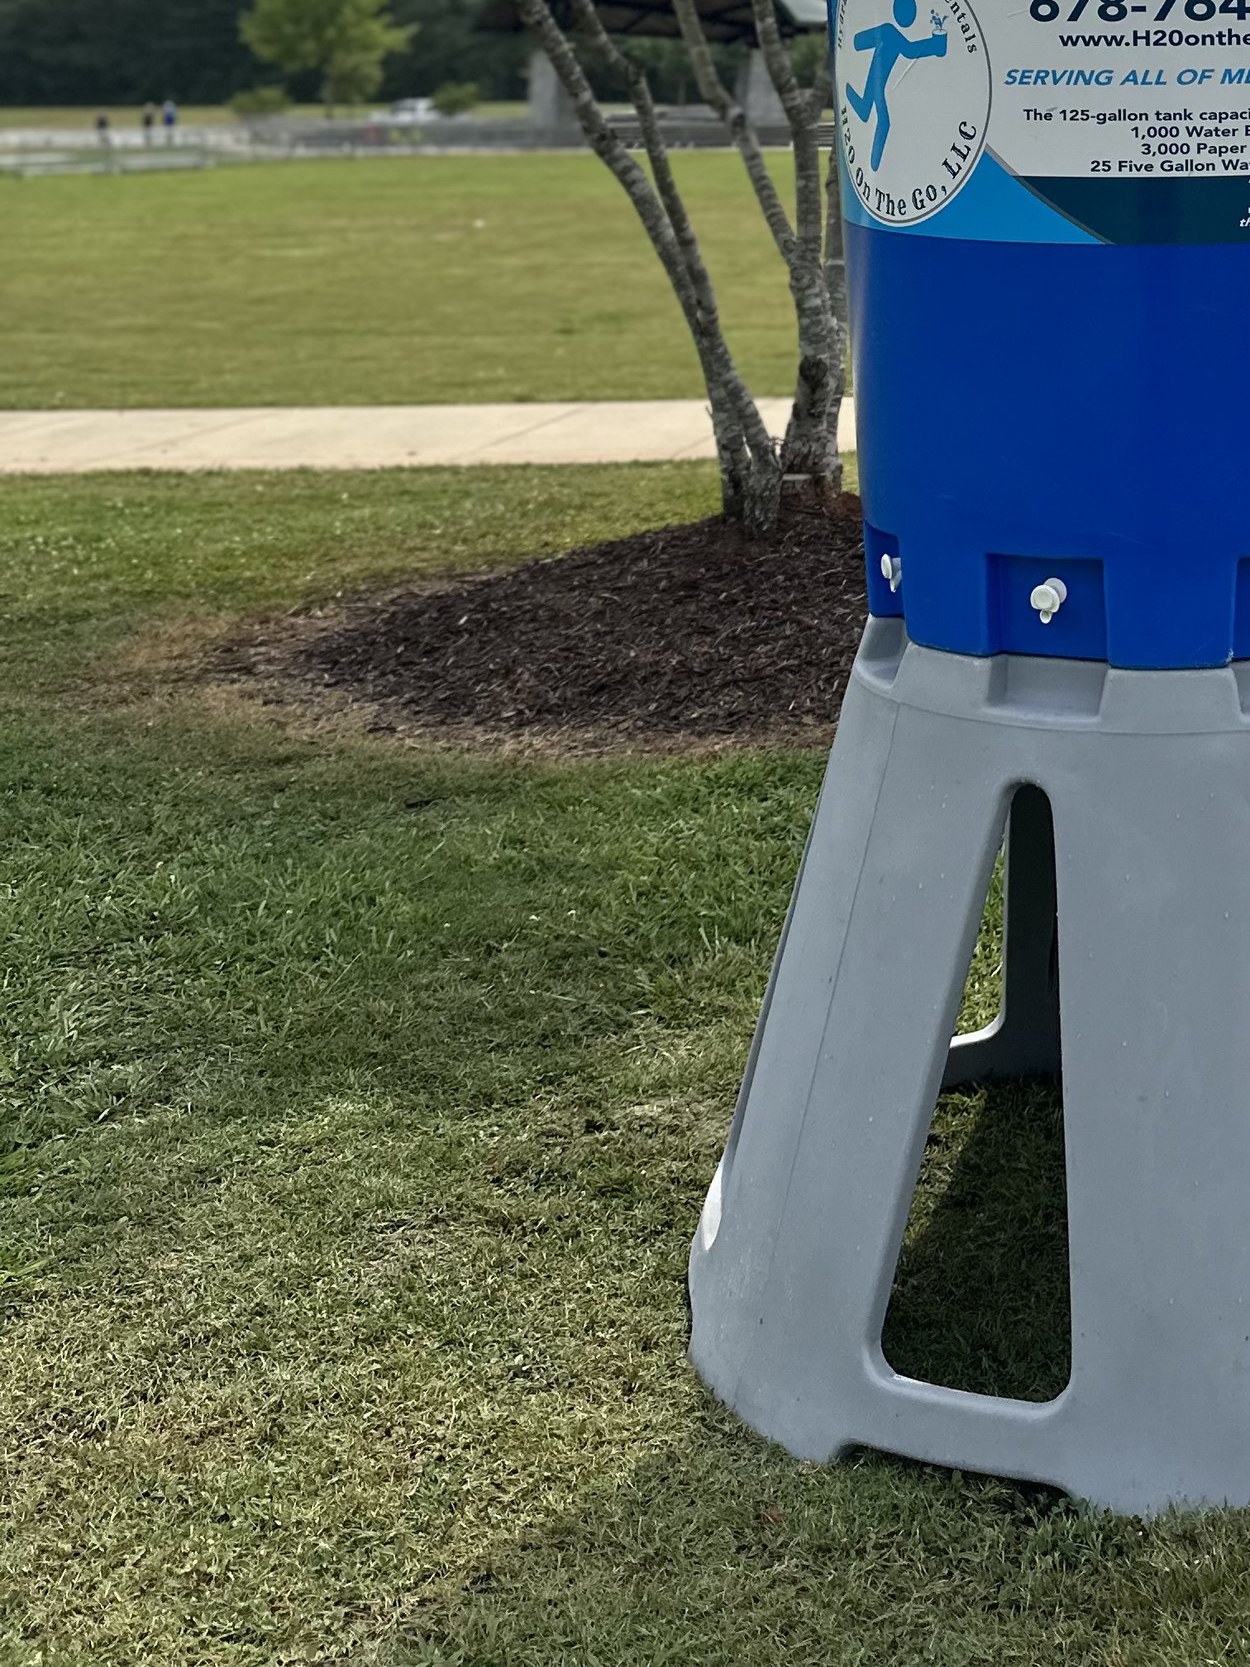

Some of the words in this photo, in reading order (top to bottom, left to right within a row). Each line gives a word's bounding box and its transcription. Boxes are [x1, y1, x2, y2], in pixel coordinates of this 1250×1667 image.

[1004, 69, 1114, 86] SERVING
[1119, 69, 1168, 86] ALL
[1176, 68, 1215, 85] OF
[1023, 109, 1053, 122] The
[1059, 109, 1149, 125] 125-gallon
[1155, 109, 1194, 121] tank
[1131, 126, 1180, 140] 1,000
[1185, 125, 1239, 138] Water
[1141, 142, 1190, 157] 3,000
[1196, 142, 1247, 157] Paper
[856, 167, 870, 202] On
[875, 187, 907, 216] The
[911, 184, 947, 210] Go,
[941, 121, 977, 180] LLC
[1090, 160, 1112, 172] 25
[1118, 160, 1154, 173] Five
[1160, 159, 1216, 172] Gallon
